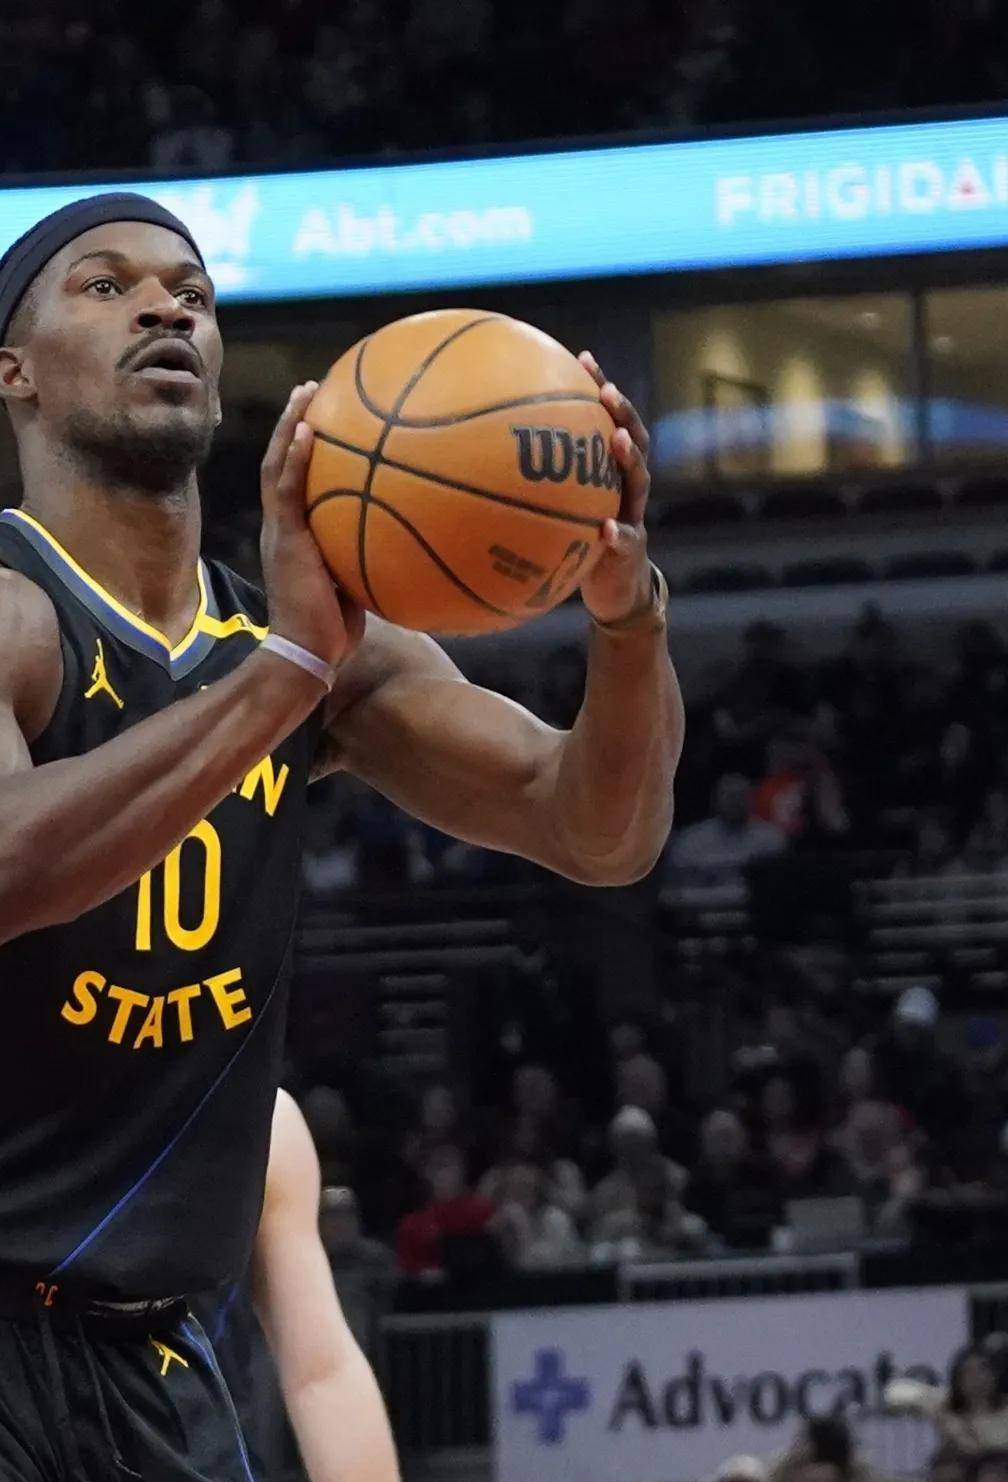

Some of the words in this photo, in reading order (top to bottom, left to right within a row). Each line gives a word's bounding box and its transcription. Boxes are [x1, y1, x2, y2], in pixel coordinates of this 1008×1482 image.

[294, 203, 533, 261] Abt.com
[135, 818, 221, 951] 10
[61, 967, 252, 1050] STATE
